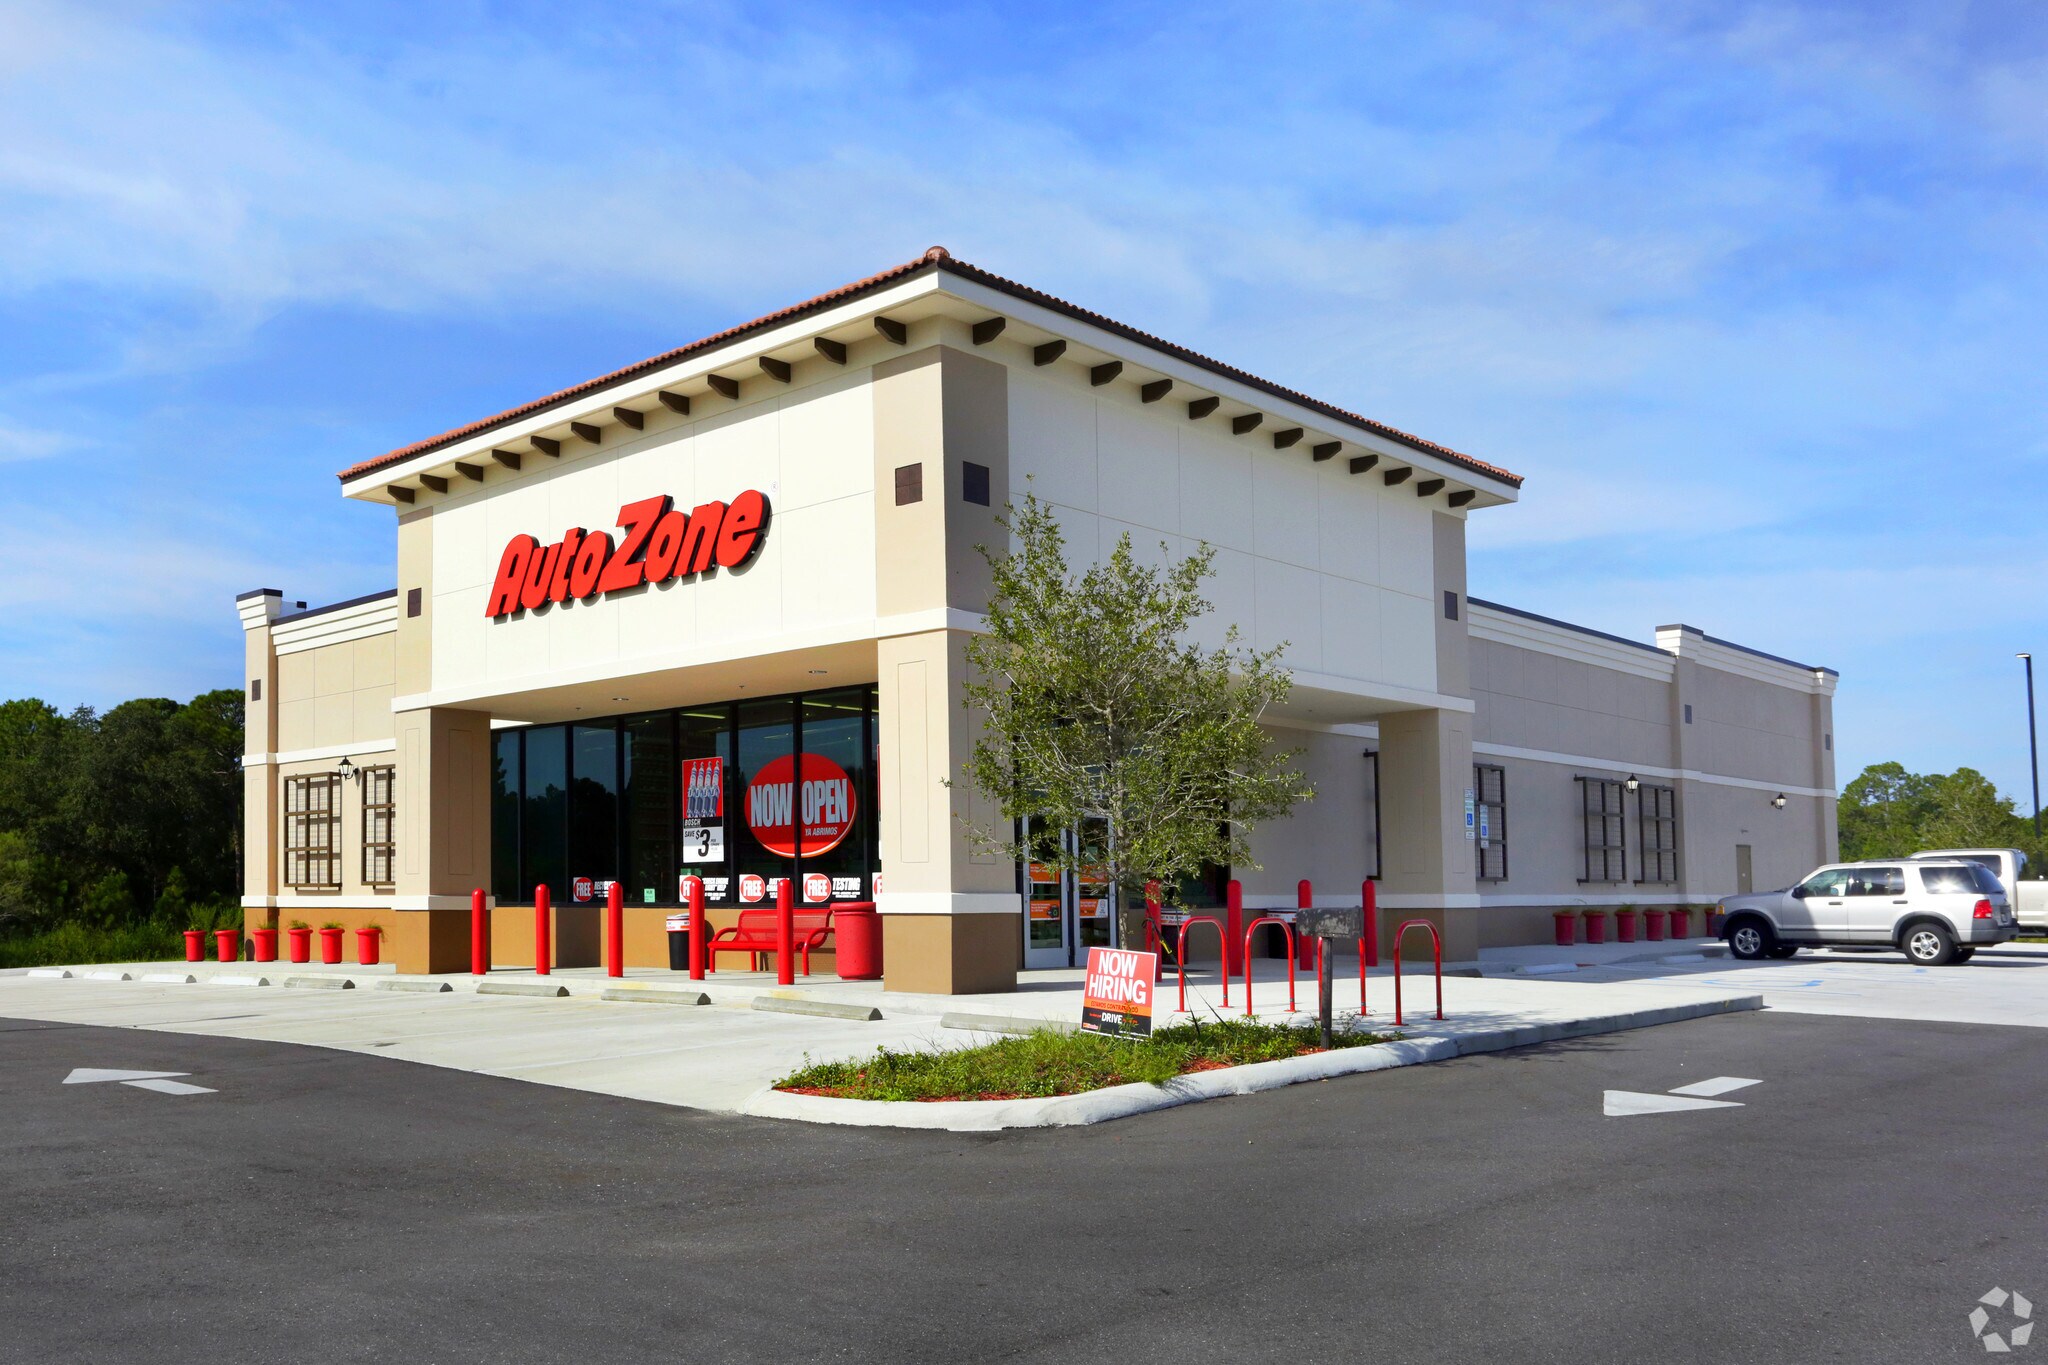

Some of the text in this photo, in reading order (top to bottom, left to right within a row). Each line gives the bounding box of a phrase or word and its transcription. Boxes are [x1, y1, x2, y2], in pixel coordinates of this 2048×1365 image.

[485, 489, 770, 618] AutoZone
[750, 778, 848, 828] NOW OPEN
[684, 818, 701, 826] BOSCH
[684, 830, 695, 838] SAVE
[805, 826, 838, 836] YA ABRIMOS
[576, 882, 591, 897] FREE
[743, 880, 762, 897] FREE
[807, 879, 828, 897] FREE
[832, 877, 861, 891] TESTING
[1098, 951, 1138, 978] NOW
[1088, 974, 1147, 1004] HIRING
[1101, 1012, 1123, 1024] DRIVE
